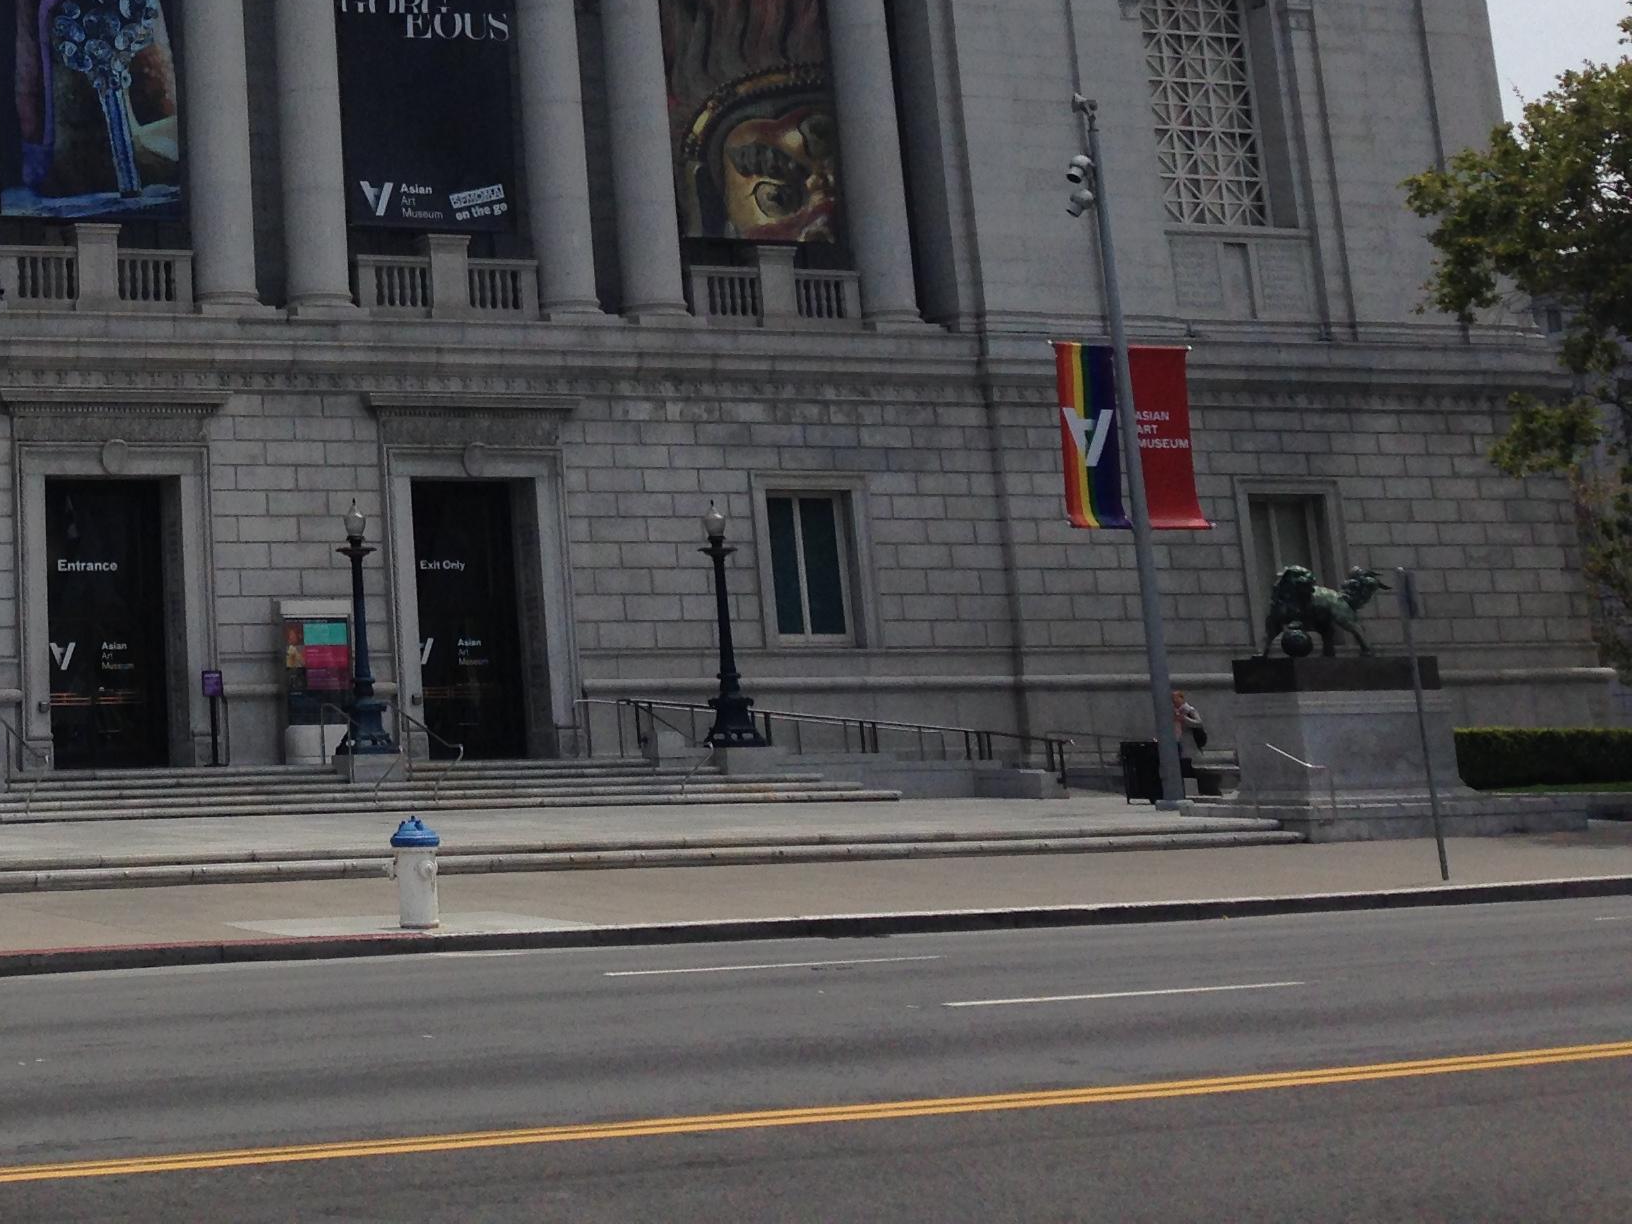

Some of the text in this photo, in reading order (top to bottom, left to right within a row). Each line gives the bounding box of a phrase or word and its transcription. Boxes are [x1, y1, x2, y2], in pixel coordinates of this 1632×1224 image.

[399, 183, 433, 194] Asian
[401, 196, 416, 206] Art
[402, 208, 444, 220] Museum
[456, 202, 508, 221] on the go
[1136, 411, 1169, 421] ASIAN
[1139, 438, 1189, 449] MUSEUM
[57, 559, 119, 572] Entrance
[420, 560, 465, 571] Exit Only
[101, 641, 128, 650] Asian
